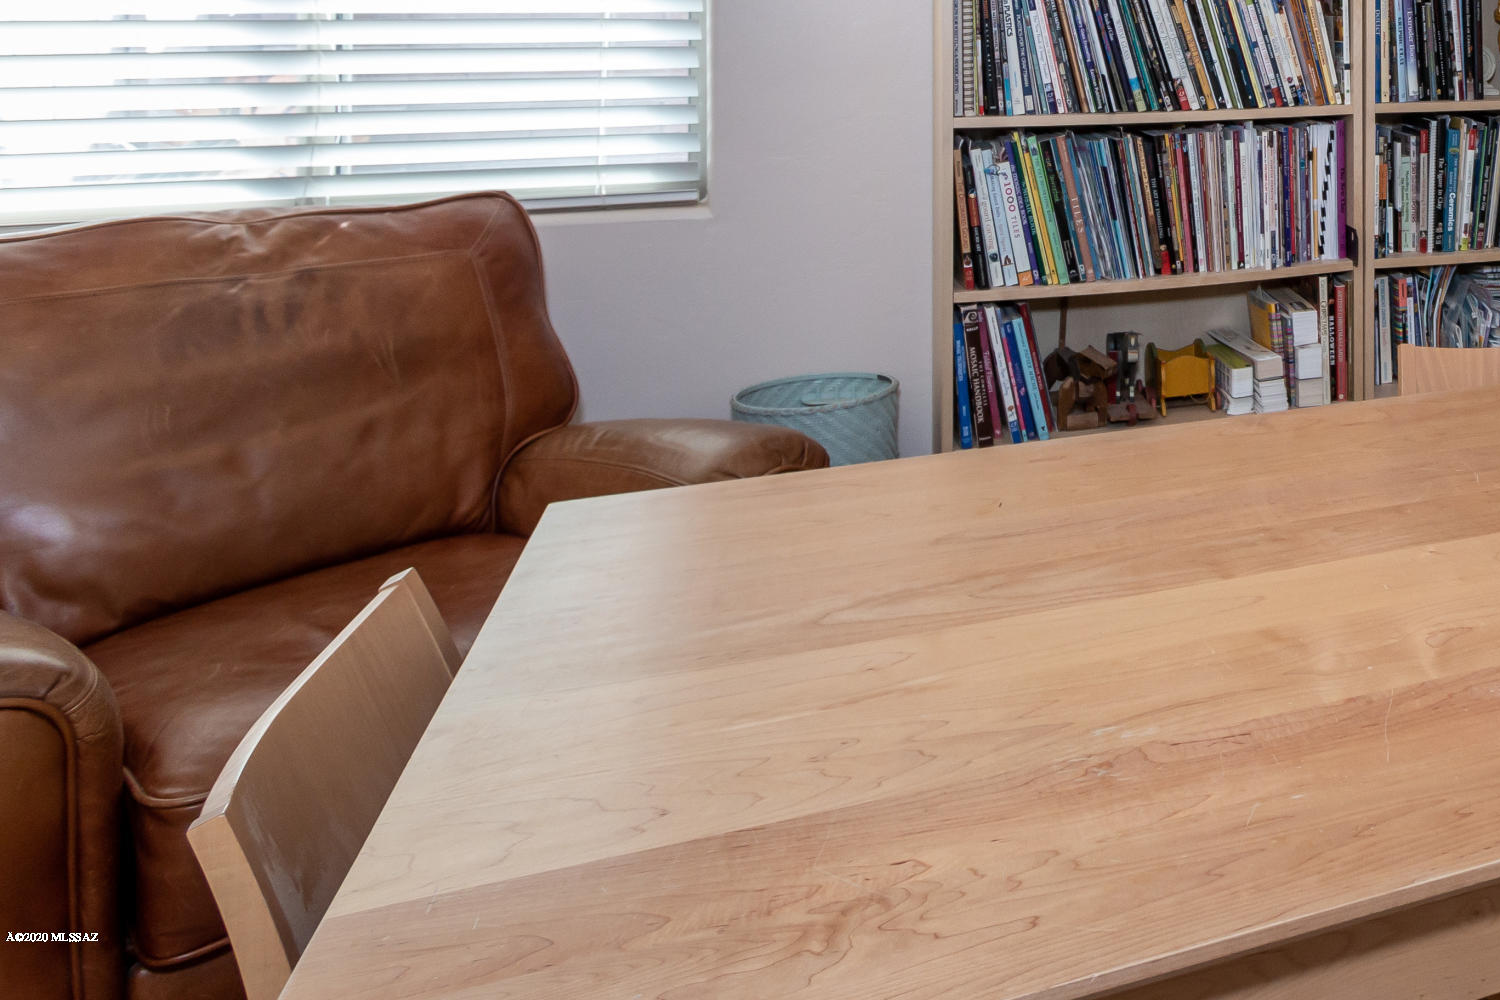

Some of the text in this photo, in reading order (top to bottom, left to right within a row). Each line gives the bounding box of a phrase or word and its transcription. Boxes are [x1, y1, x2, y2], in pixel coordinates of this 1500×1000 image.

[1004, 5, 1013, 36] PLASTICS
[1004, 181, 1018, 212] 1000
[1446, 192, 1456, 231] Ceramics
[967, 346, 984, 423] MOSAIC HANDBOOK
